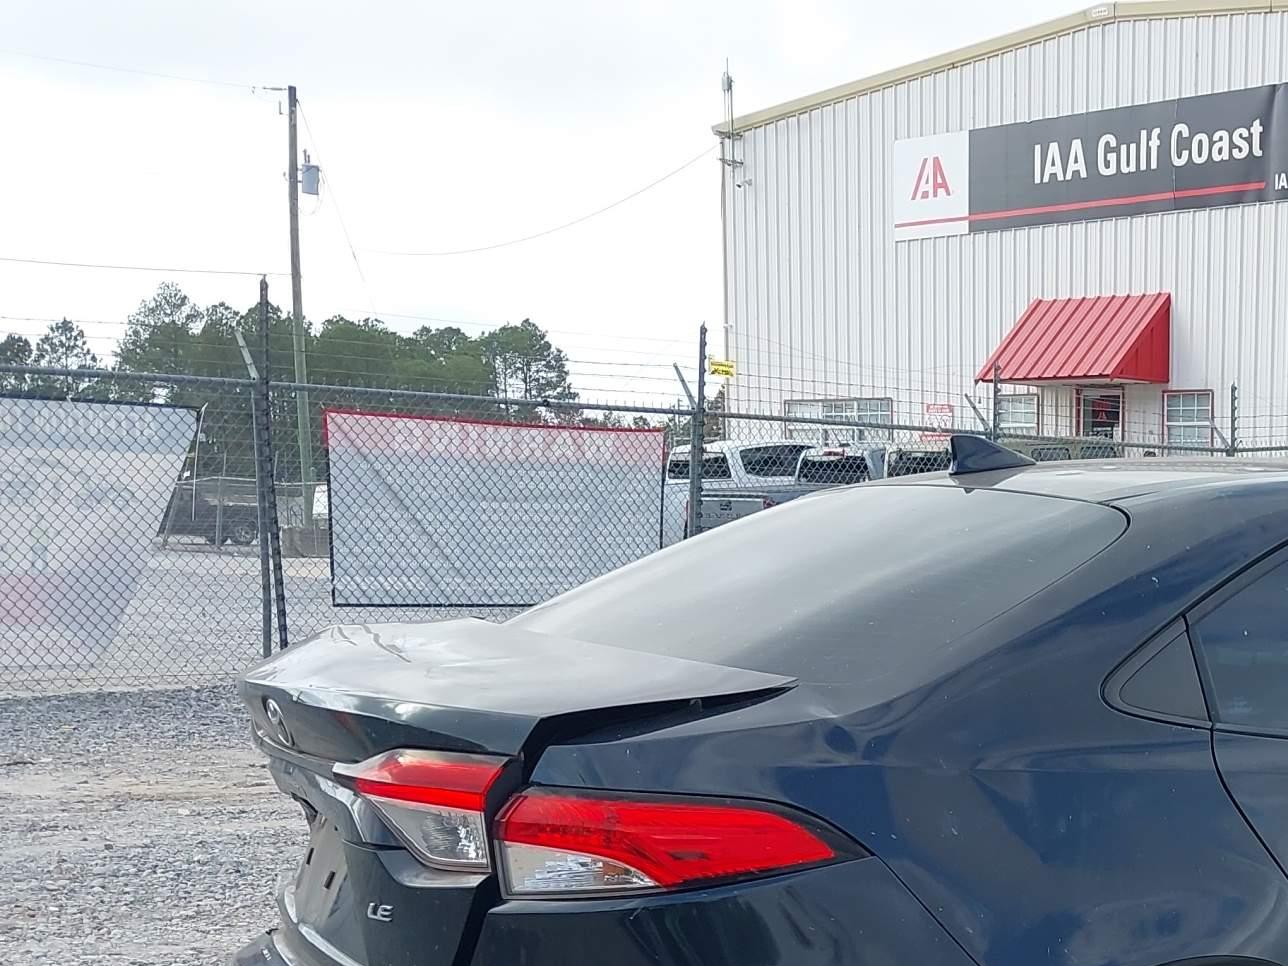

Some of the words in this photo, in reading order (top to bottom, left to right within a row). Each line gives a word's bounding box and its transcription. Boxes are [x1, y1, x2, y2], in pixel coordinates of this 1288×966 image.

[1034, 138, 1088, 185] IAA
[1097, 127, 1161, 176] Gulf
[1170, 118, 1264, 167] Coast
[367, 902, 394, 922] LE
